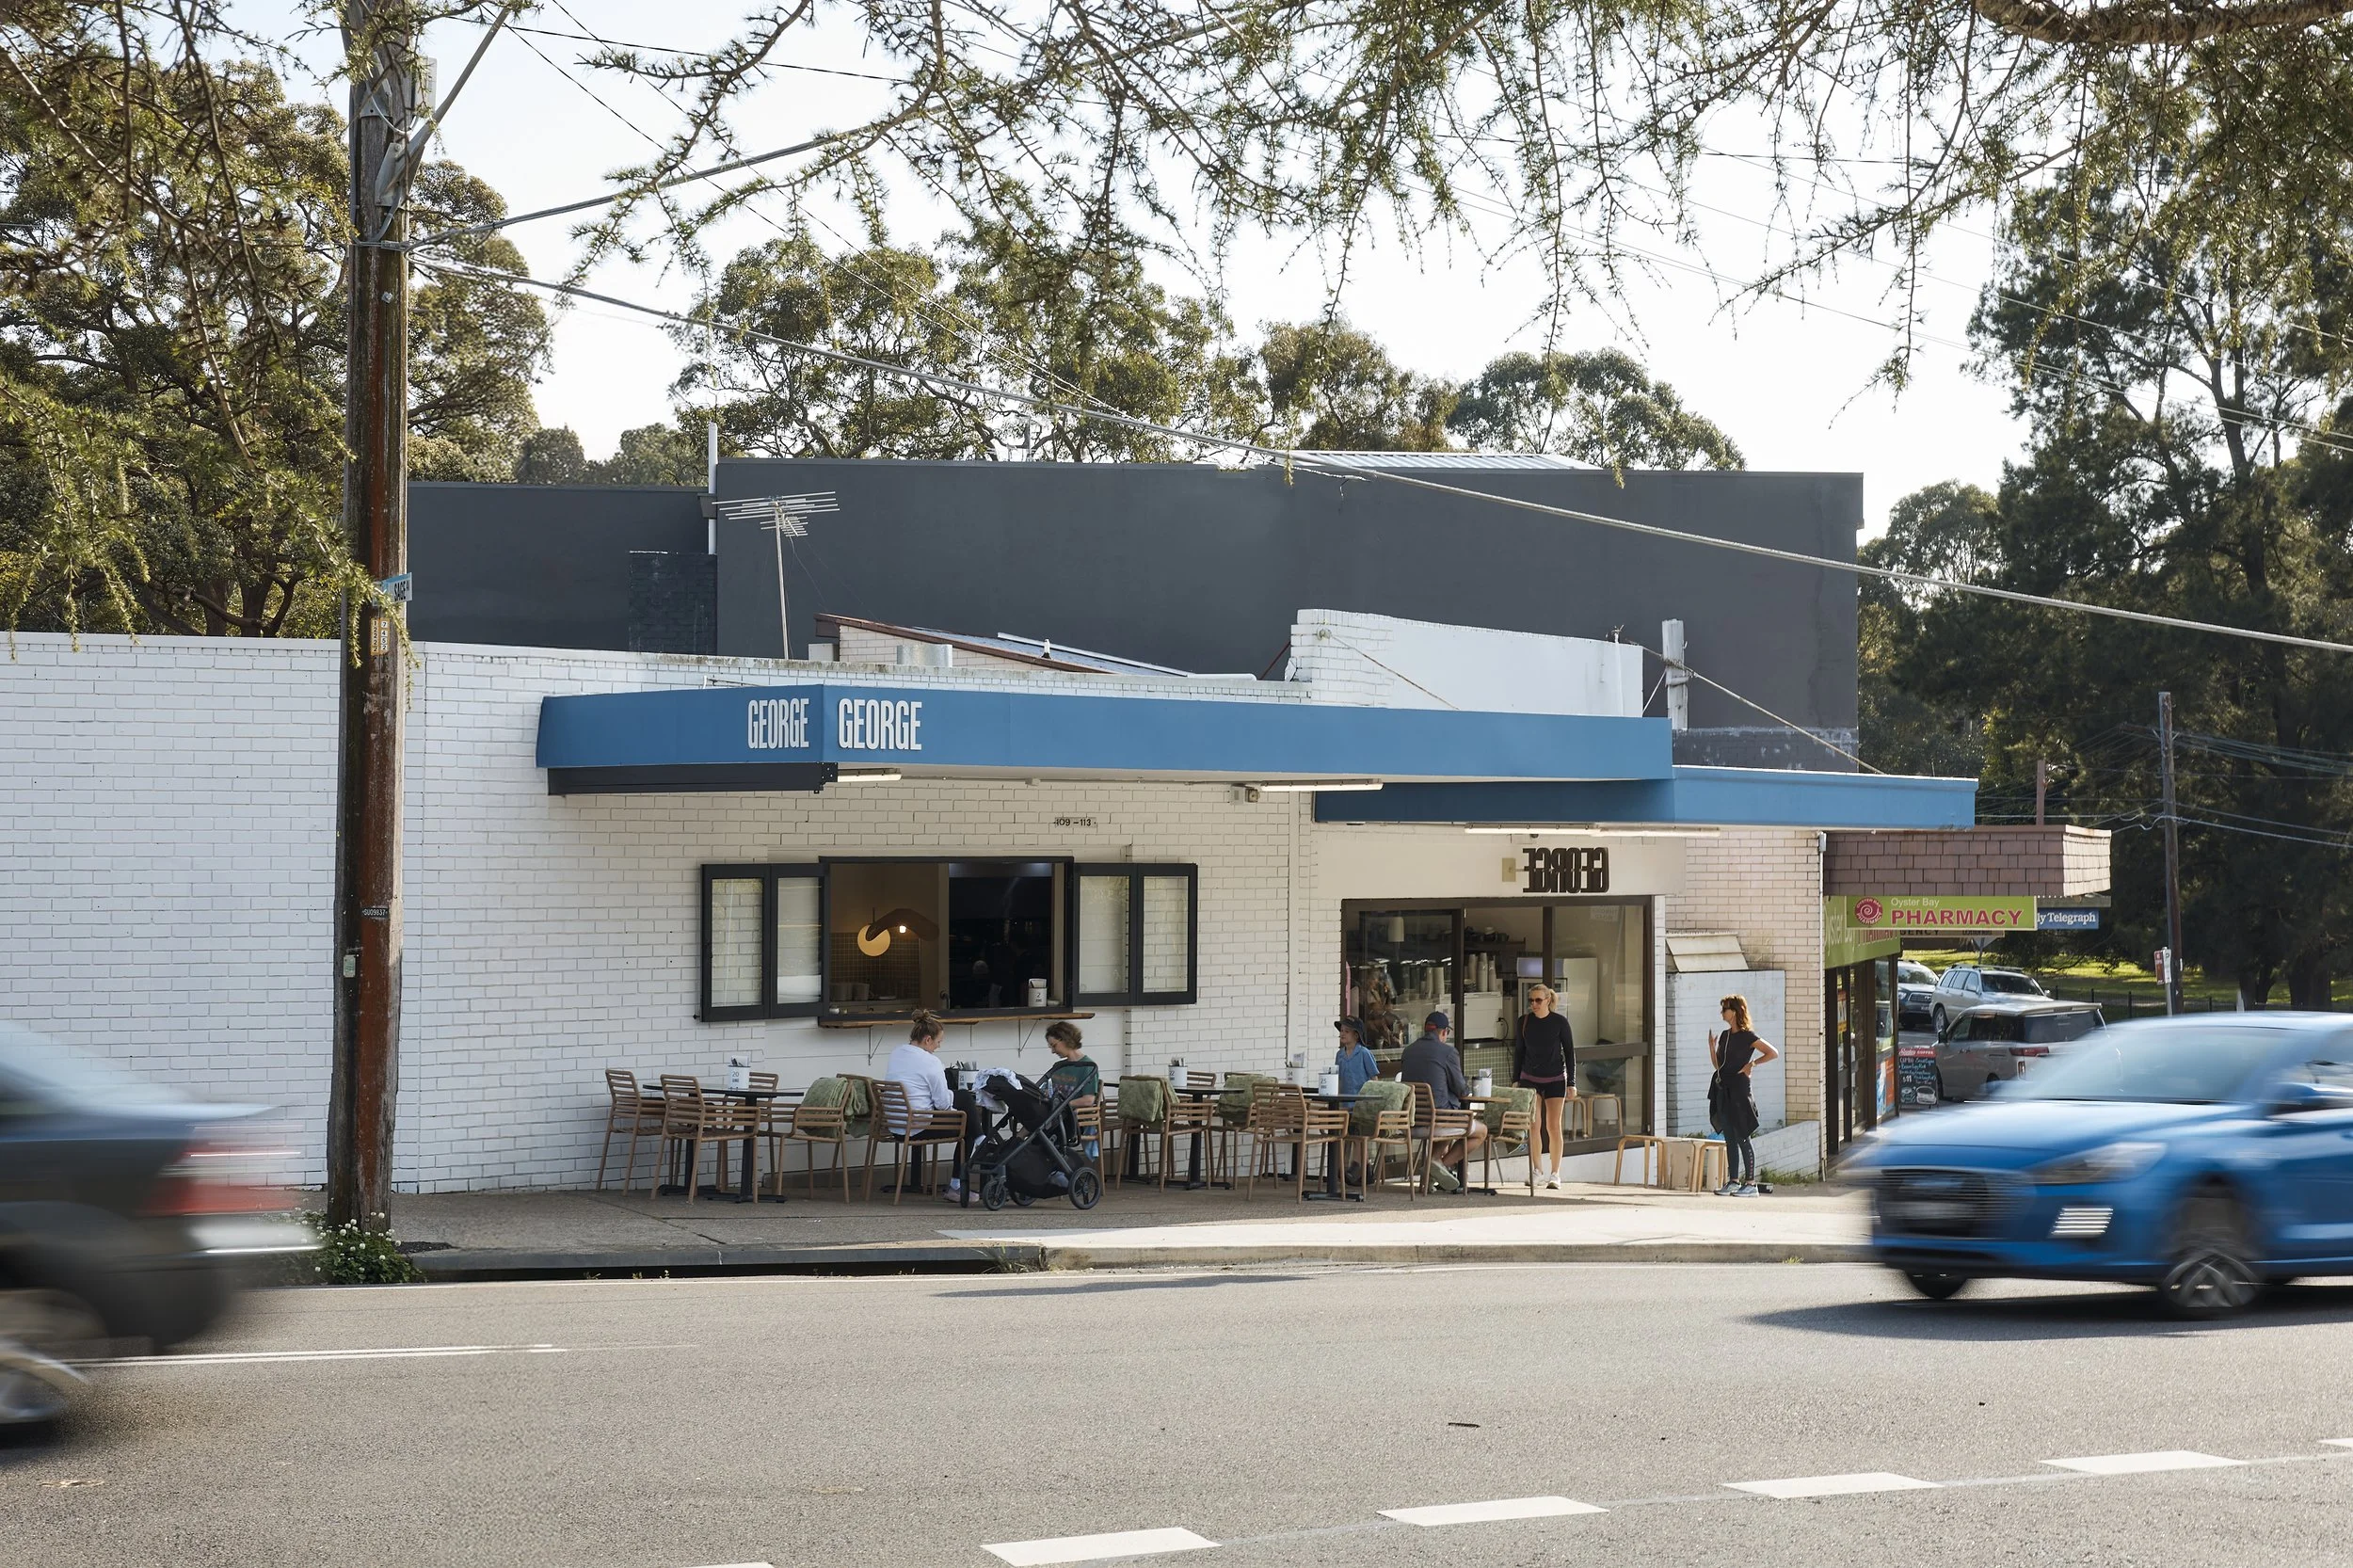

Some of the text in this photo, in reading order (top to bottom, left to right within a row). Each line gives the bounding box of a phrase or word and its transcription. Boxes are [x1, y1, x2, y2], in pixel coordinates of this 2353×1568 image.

[747, 697, 810, 749] GEORGE
[838, 697, 922, 750] GEORGE
[1890, 897, 1940, 907] Oyster Bay
[1856, 911, 1882, 925] PHARMACY
[1890, 908, 2024, 927] PHARMACY
[2047, 912, 2096, 925] Telegraph
